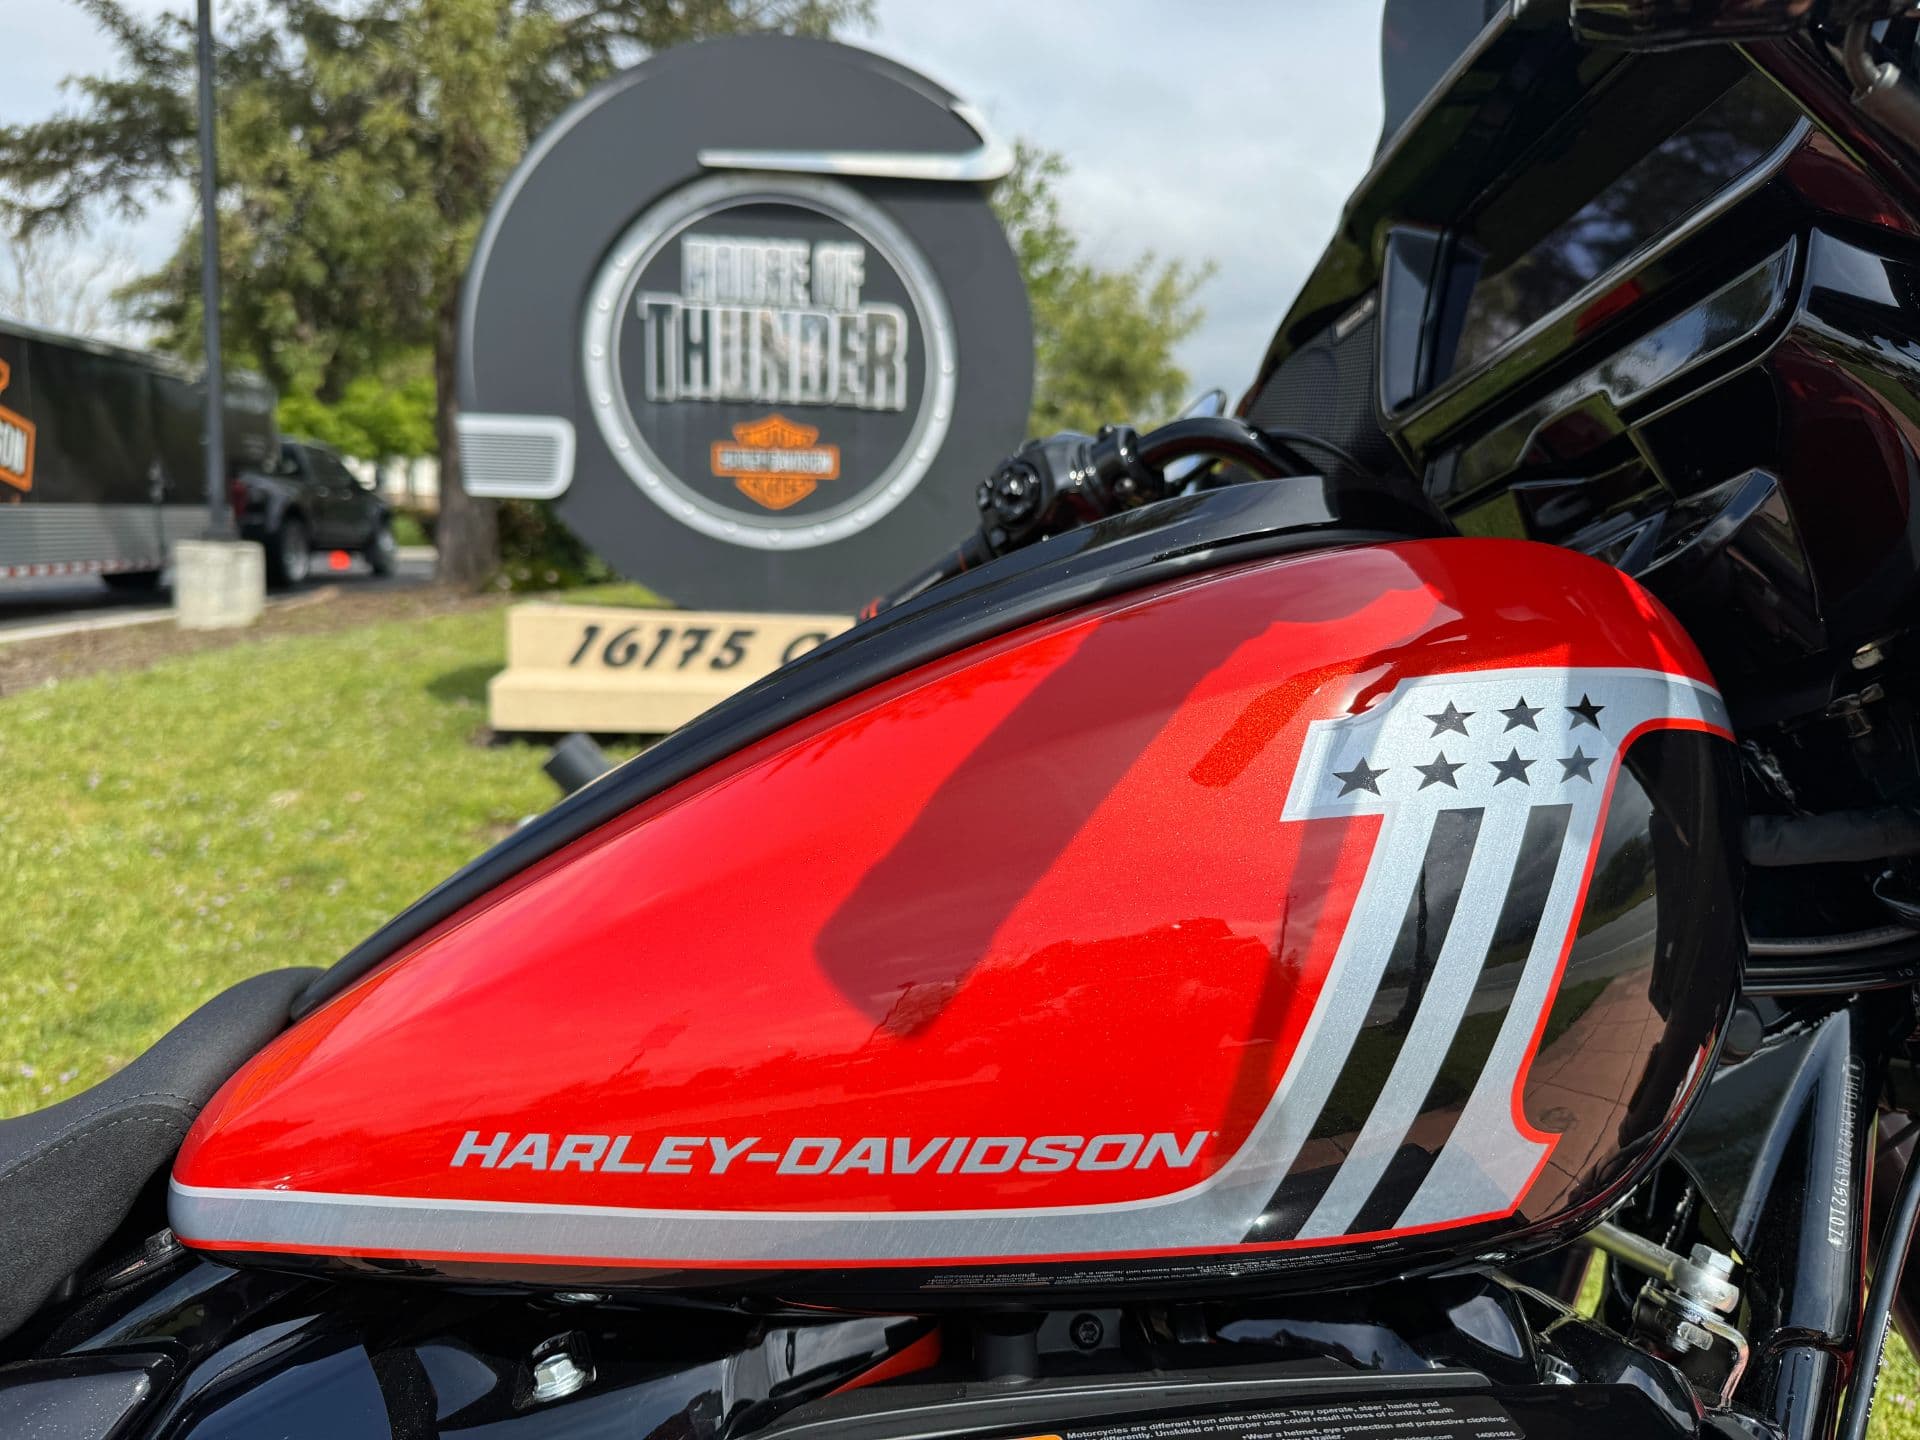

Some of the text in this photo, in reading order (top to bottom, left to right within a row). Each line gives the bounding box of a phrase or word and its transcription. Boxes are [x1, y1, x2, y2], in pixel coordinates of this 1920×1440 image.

[812, 240, 865, 312] OF
[637, 291, 908, 411] THUNDER
[569, 625, 755, 670] 16175
[450, 1131, 1210, 1175] HARLEY-DAVIDSON
[1066, 1427, 1129, 1440] Motorcycles
[1149, 1419, 1191, 1430] different
[1193, 1418, 1216, 1426] from
[1218, 1414, 1245, 1423] other
[1246, 1411, 1290, 1421] vehicles.
[1290, 1409, 1314, 1417] They
[1386, 1402, 1420, 1410] handle
[1155, 1426, 1202, 1438] Unskilled
[1216, 1421, 1261, 1432] improper
[1283, 1416, 1311, 1424] could
[1312, 1414, 1341, 1422] result
[1342, 1423, 1394, 1433] protection
[1395, 1420, 1414, 1428] and
[1415, 1418, 1465, 1428] protective
[1466, 1416, 1509, 1424] clothing.
